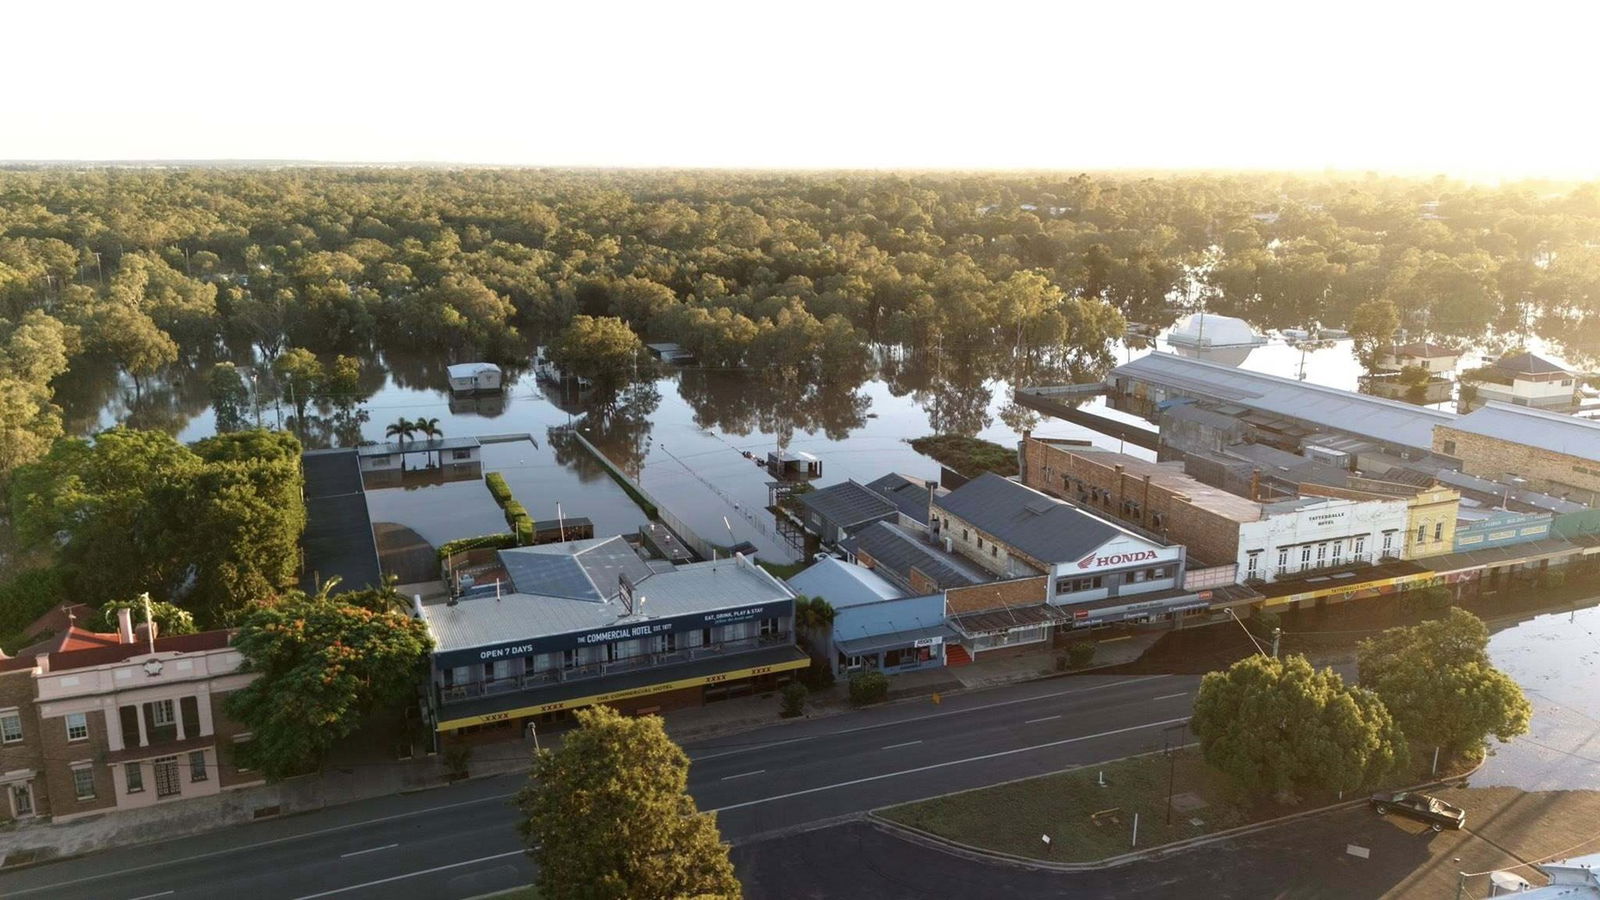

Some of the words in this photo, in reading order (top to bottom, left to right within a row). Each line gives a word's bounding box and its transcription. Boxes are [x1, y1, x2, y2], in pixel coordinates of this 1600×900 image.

[1096, 550, 1158, 567] HONDA
[716, 612, 733, 620] DRINK,
[586, 628, 631, 644] COMMERCIAL
[632, 625, 652, 636] HOTEL
[480, 649, 504, 659] OPEN
[512, 644, 533, 654] DAYS
[752, 666, 772, 674] XXXX
[706, 674, 728, 682] XXXX
[610, 688, 652, 699] COMMERCIAL
[540, 703, 565, 712] XXXX
[485, 712, 510, 722] XXXX
